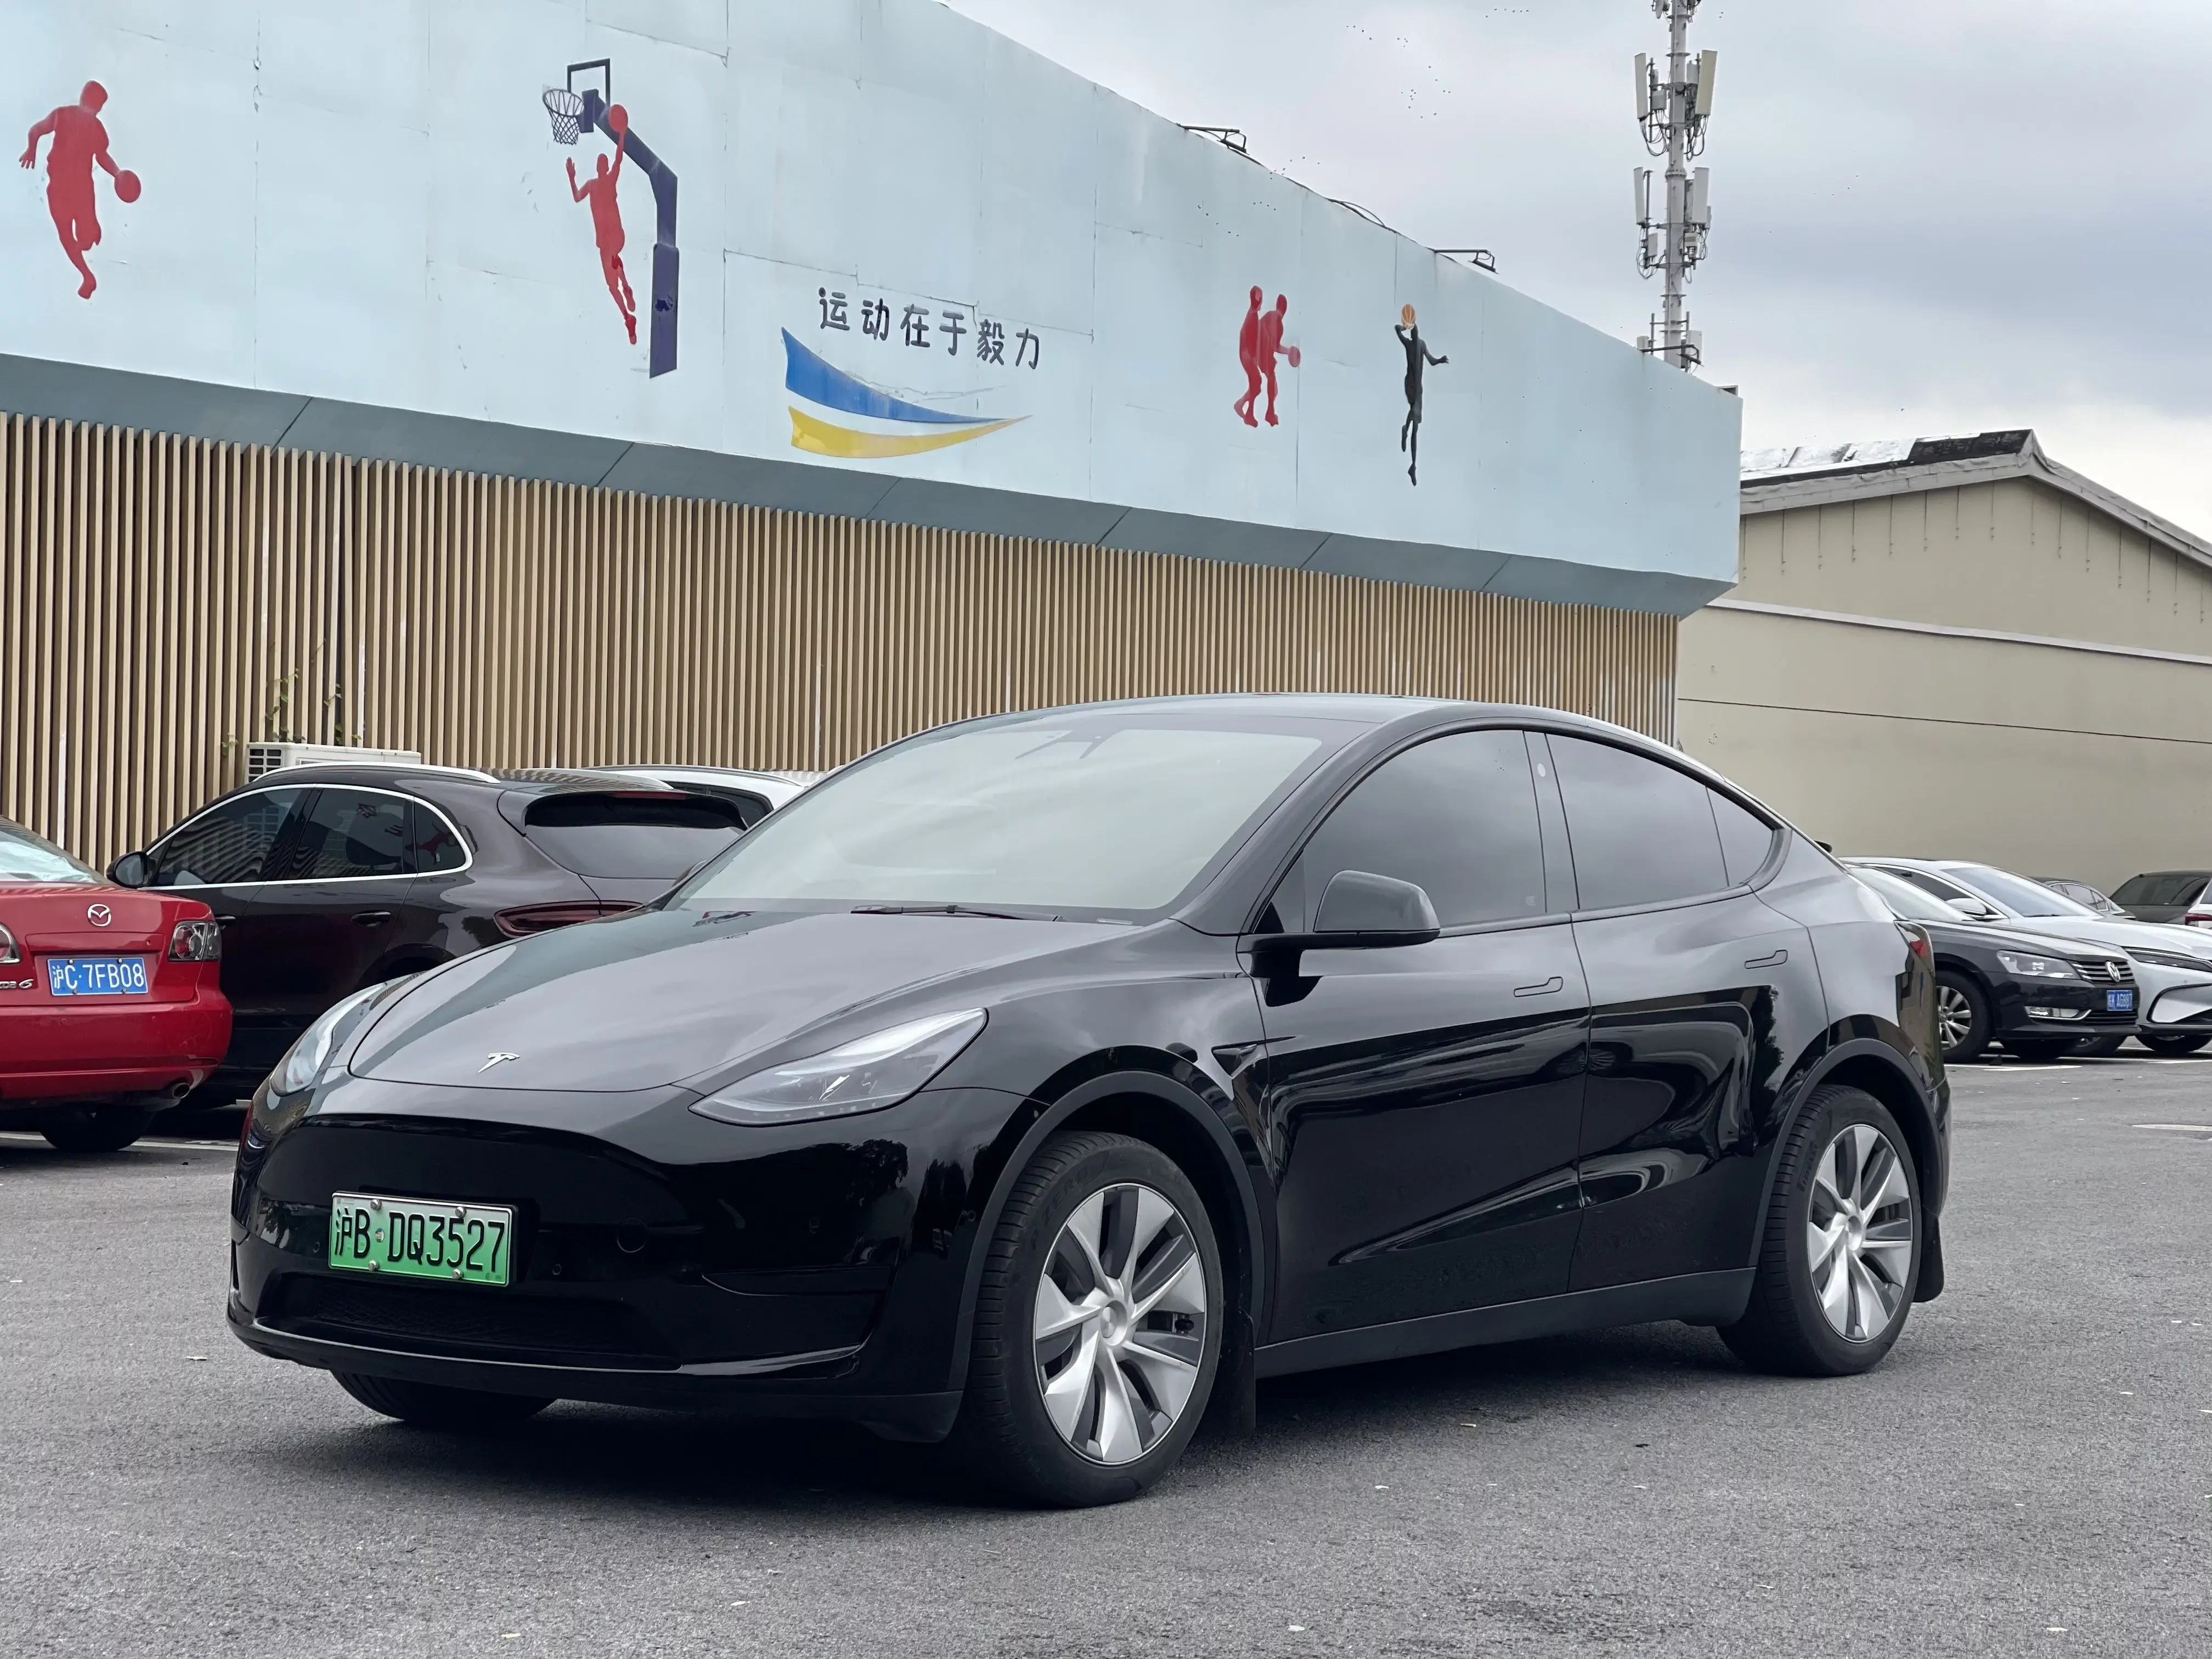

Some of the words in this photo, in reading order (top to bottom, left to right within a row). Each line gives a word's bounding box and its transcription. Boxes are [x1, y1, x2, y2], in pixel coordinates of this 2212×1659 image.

[818, 287, 1040, 370] 运动在于毅力
[387, 1210, 505, 1272] DQ3527
